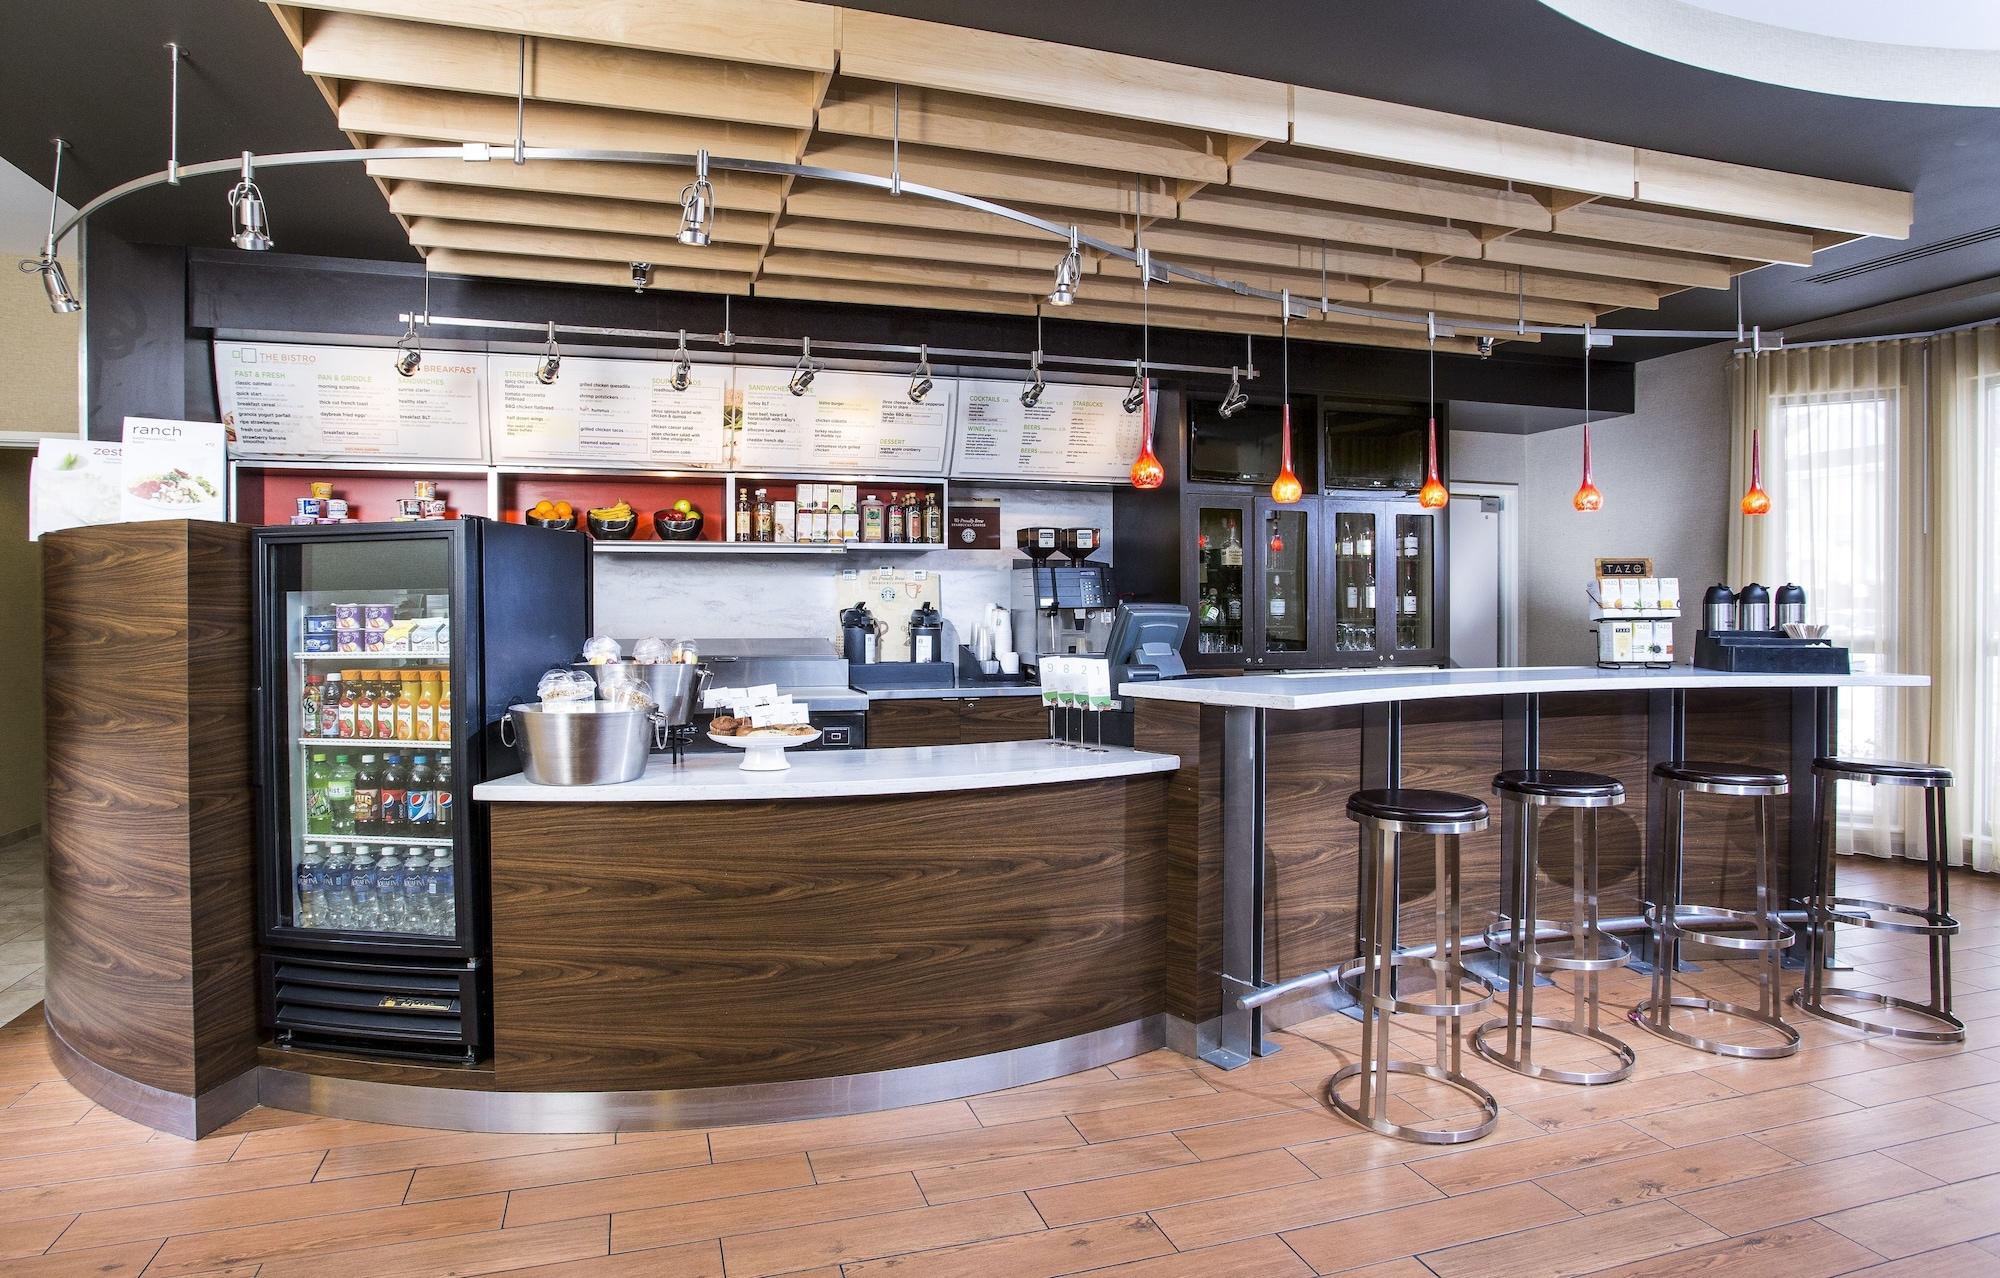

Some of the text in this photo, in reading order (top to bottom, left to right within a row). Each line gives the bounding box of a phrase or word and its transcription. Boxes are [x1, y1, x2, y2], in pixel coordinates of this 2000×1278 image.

[260, 352, 317, 363] THE BISTRO
[423, 364, 477, 374] BREAKFAST
[234, 370, 252, 378] FAST
[261, 371, 286, 379] FRESH
[1072, 400, 1104, 408] STARBUCKS
[132, 424, 182, 437] ranch
[93, 447, 122, 457] zest
[1606, 564, 1642, 574] TAZO
[1047, 663, 1054, 673] 9
[1063, 663, 1070, 674] 8
[1081, 664, 1087, 675] 2
